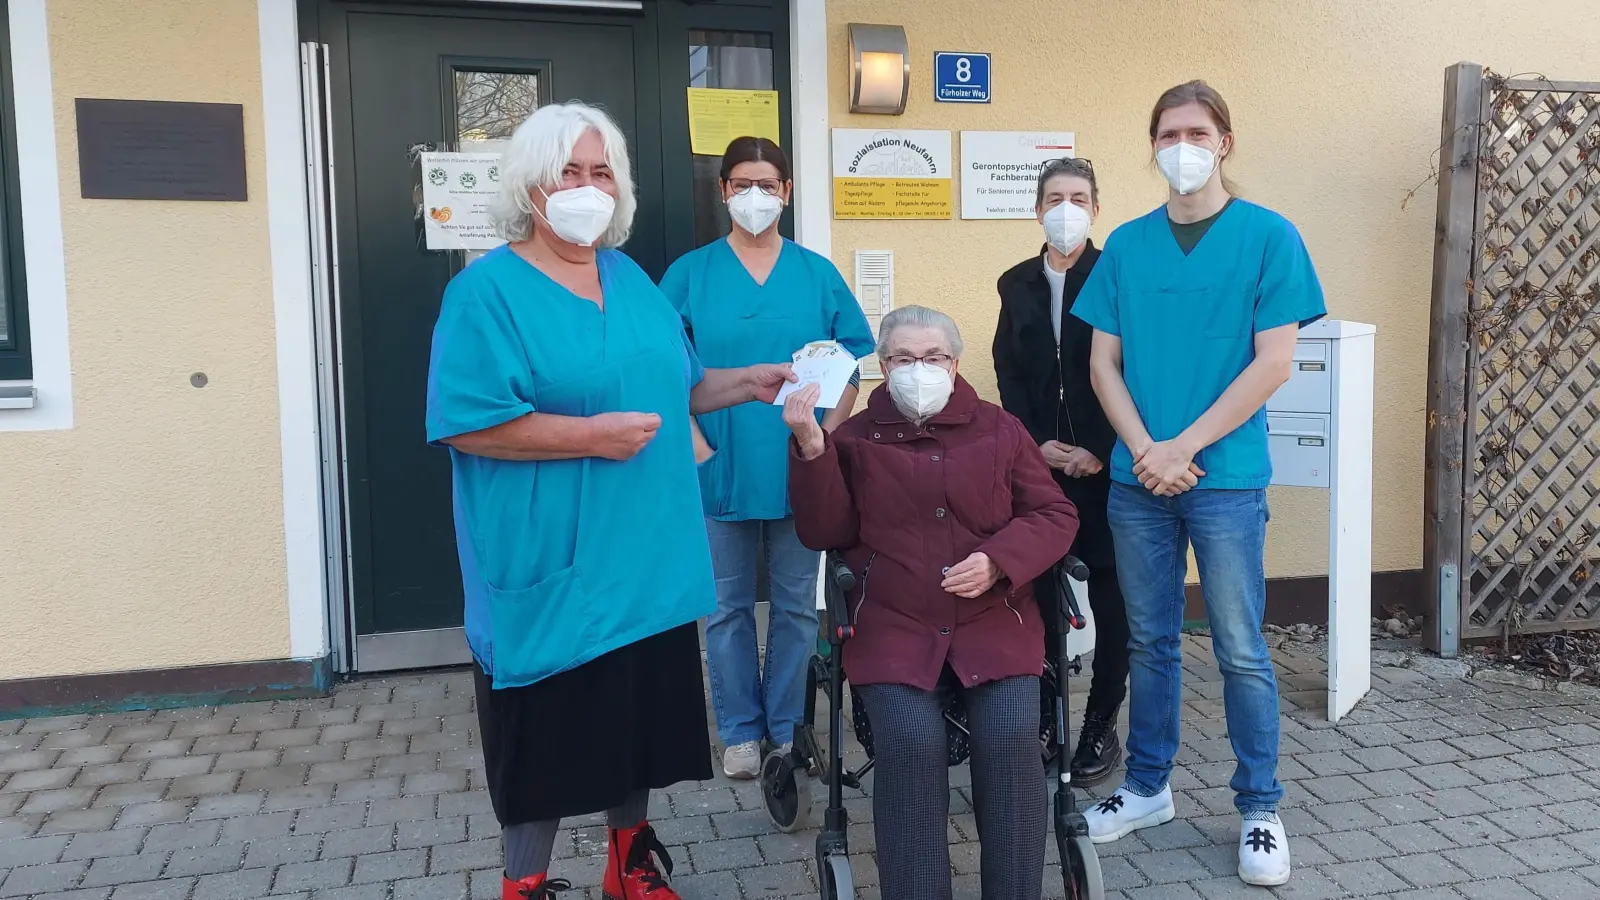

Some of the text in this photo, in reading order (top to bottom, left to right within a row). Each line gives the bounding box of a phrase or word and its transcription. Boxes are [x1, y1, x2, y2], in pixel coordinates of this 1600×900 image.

[956, 57, 971, 83] 8
[941, 88, 986, 99] Fürholzer Weg
[848, 138, 937, 174] Sozialstation Neufahrn
[972, 162, 1041, 172] Gerontopsychiat
[976, 187, 987, 195] Für
[988, 187, 1015, 195] Senioren
[1015, 187, 1027, 195] und
